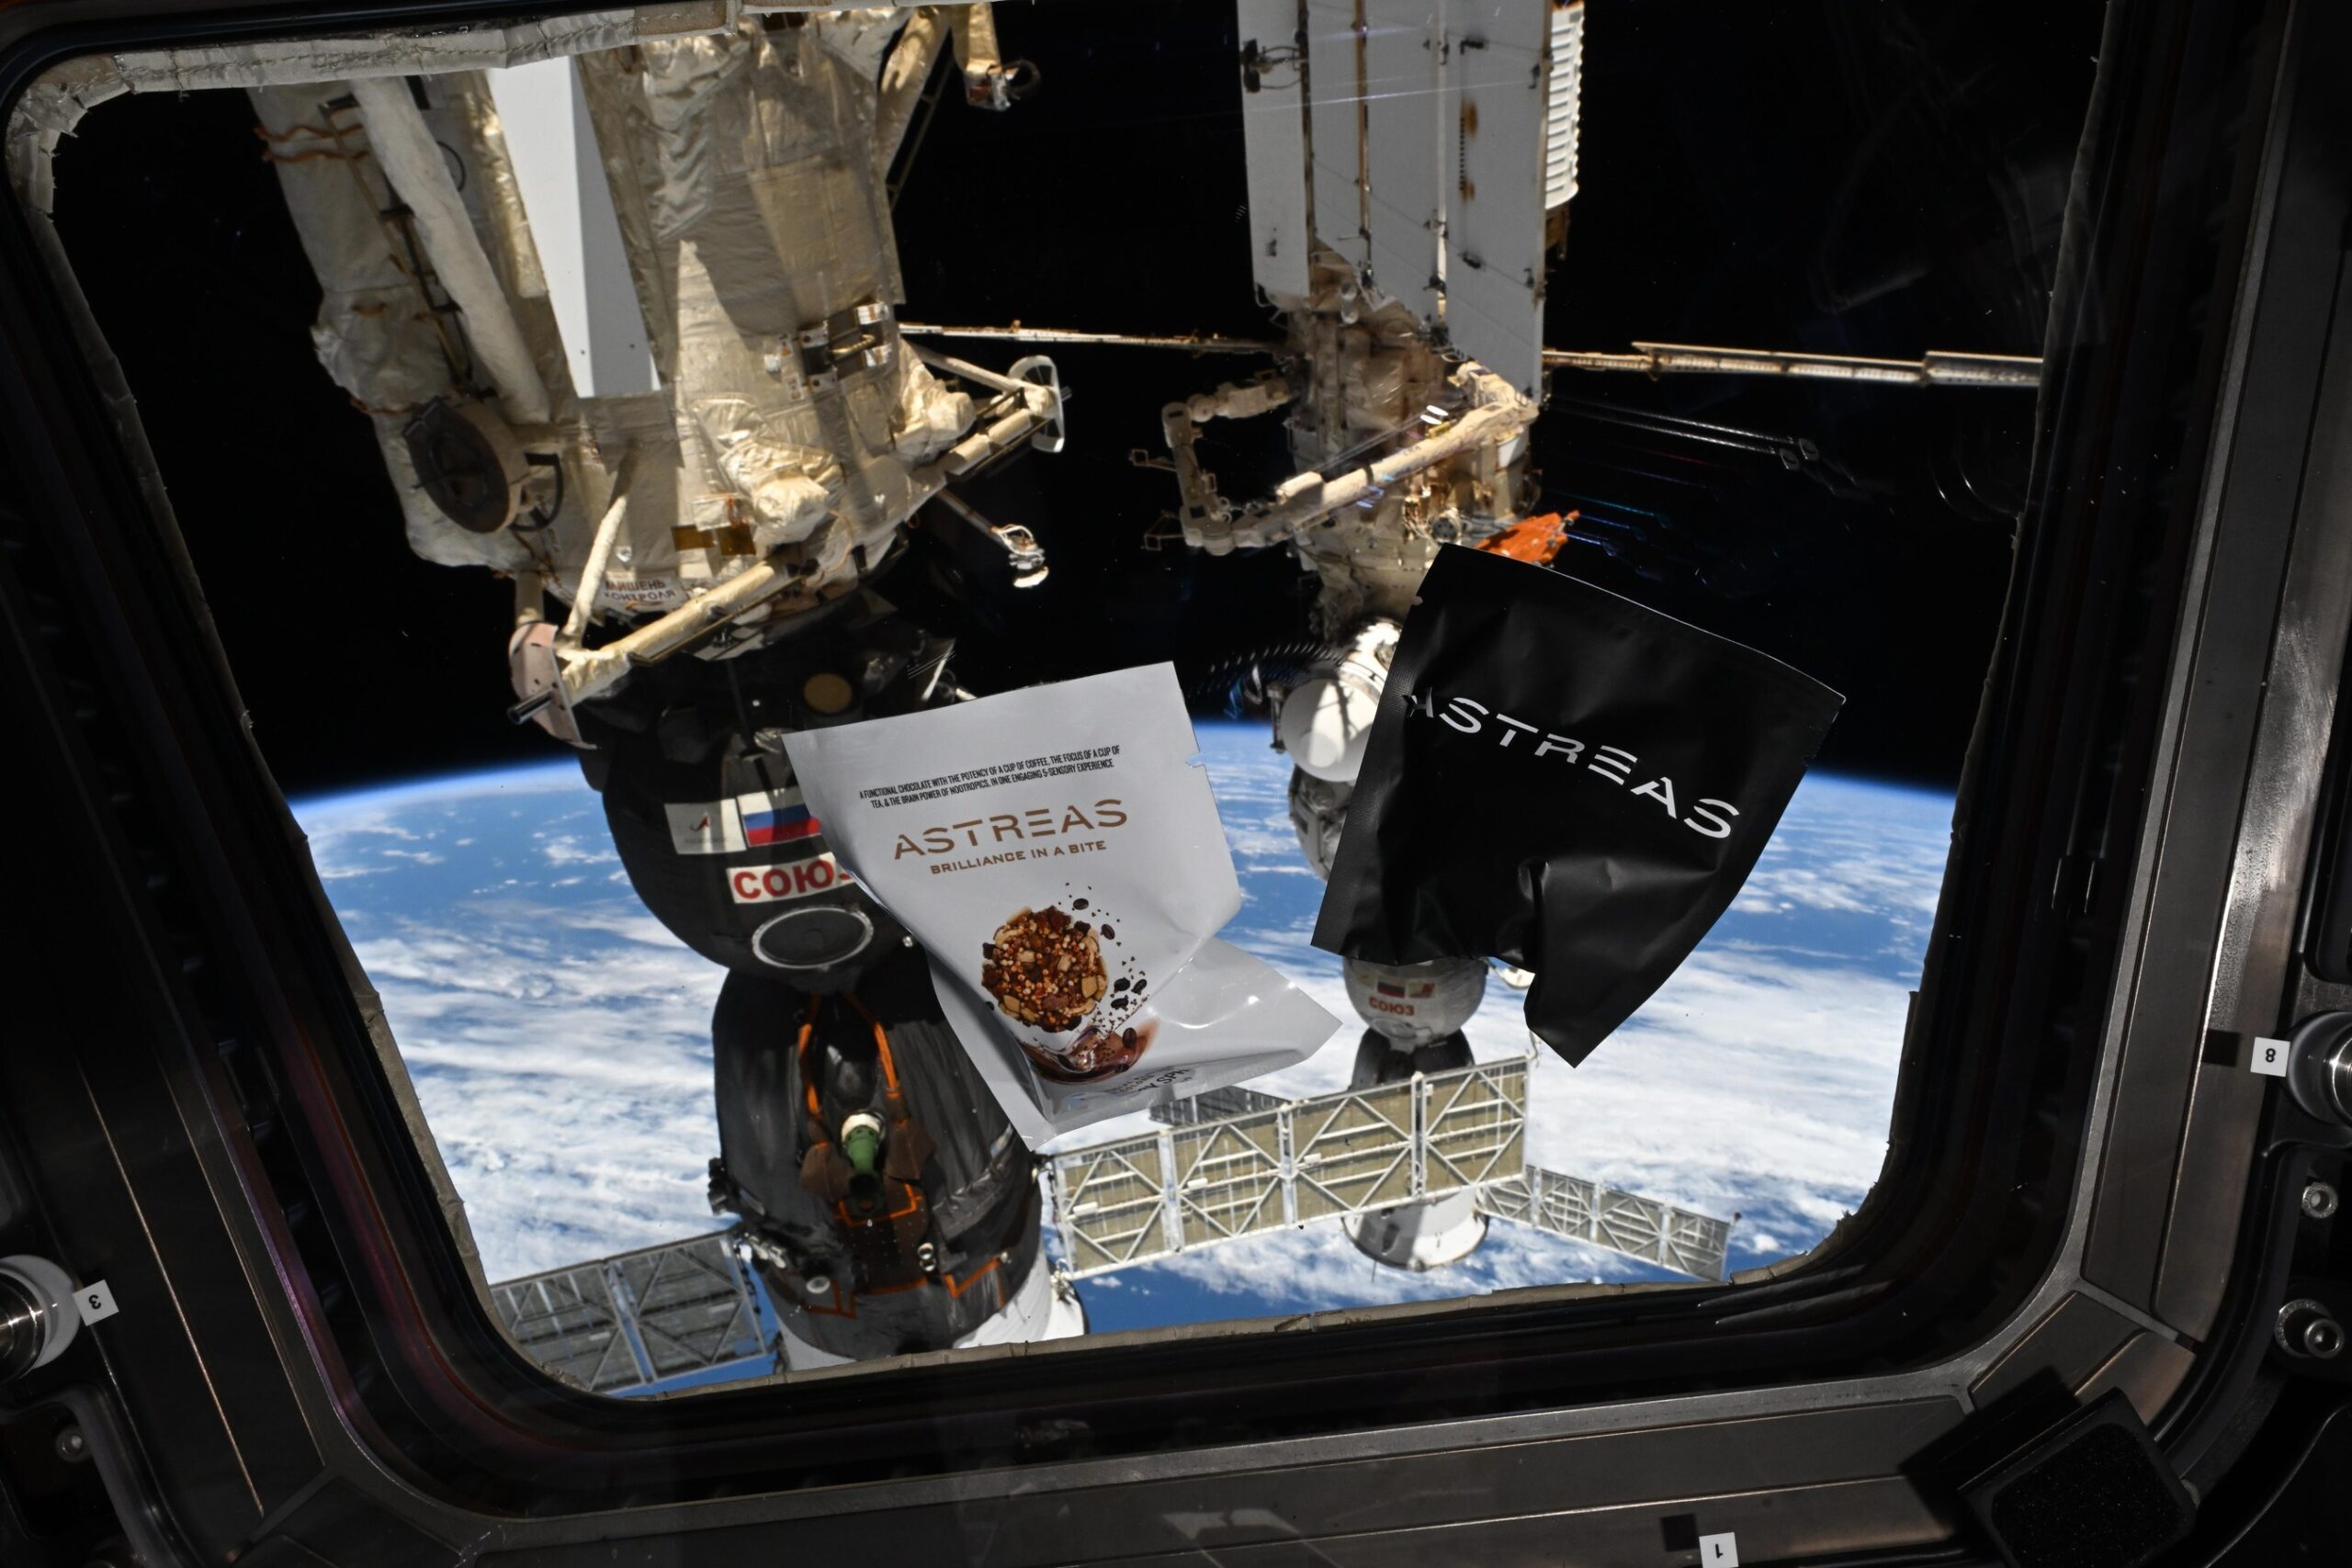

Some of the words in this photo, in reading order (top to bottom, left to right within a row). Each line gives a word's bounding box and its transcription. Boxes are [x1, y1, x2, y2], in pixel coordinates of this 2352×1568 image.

[859, 790, 865, 799] A
[864, 786, 899, 798] FUNCTIONAL
[898, 780, 932, 794] CHOCOLATE
[932, 776, 948, 787] WITH
[948, 773, 961, 784] THE
[960, 768, 989, 781] POTENCY
[989, 766, 997, 775] OF
[998, 765, 1004, 773] A
[1003, 762, 1015, 773] CUP
[1016, 761, 1023, 770] OF
[1049, 754, 1063, 764] THE
[1063, 751, 1084, 762] FOCUS
[1083, 750, 1091, 760] OF
[1092, 749, 1099, 759] A
[1097, 746, 1111, 757] CUP
[1111, 745, 1120, 755] OF
[1408, 686, 1739, 839] ASTREAS
[884, 798, 890, 807] &
[889, 796, 901, 806] THE
[901, 793, 920, 805] BRAIN
[919, 789, 942, 801] POWER
[941, 787, 949, 797] OF
[990, 777, 999, 787] IN
[998, 774, 1012, 785] ONE
[1011, 769, 1043, 783] ENGAGING
[1042, 763, 1076, 778] 5-SENSORY
[894, 798, 1128, 861] ASTREAS
[930, 851, 1027, 874] BRILLIANCE
[1030, 846, 1048, 859] IN
[1053, 844, 1066, 856] A
[1068, 840, 1107, 854] BITE
[733, 860, 851, 899] СОЮ
[1368, 996, 1415, 1016] СОЮЗ
[2265, 1047, 2277, 1064] 8
[88, 1294, 102, 1310] 3
[1714, 1543, 1724, 1559] 1
